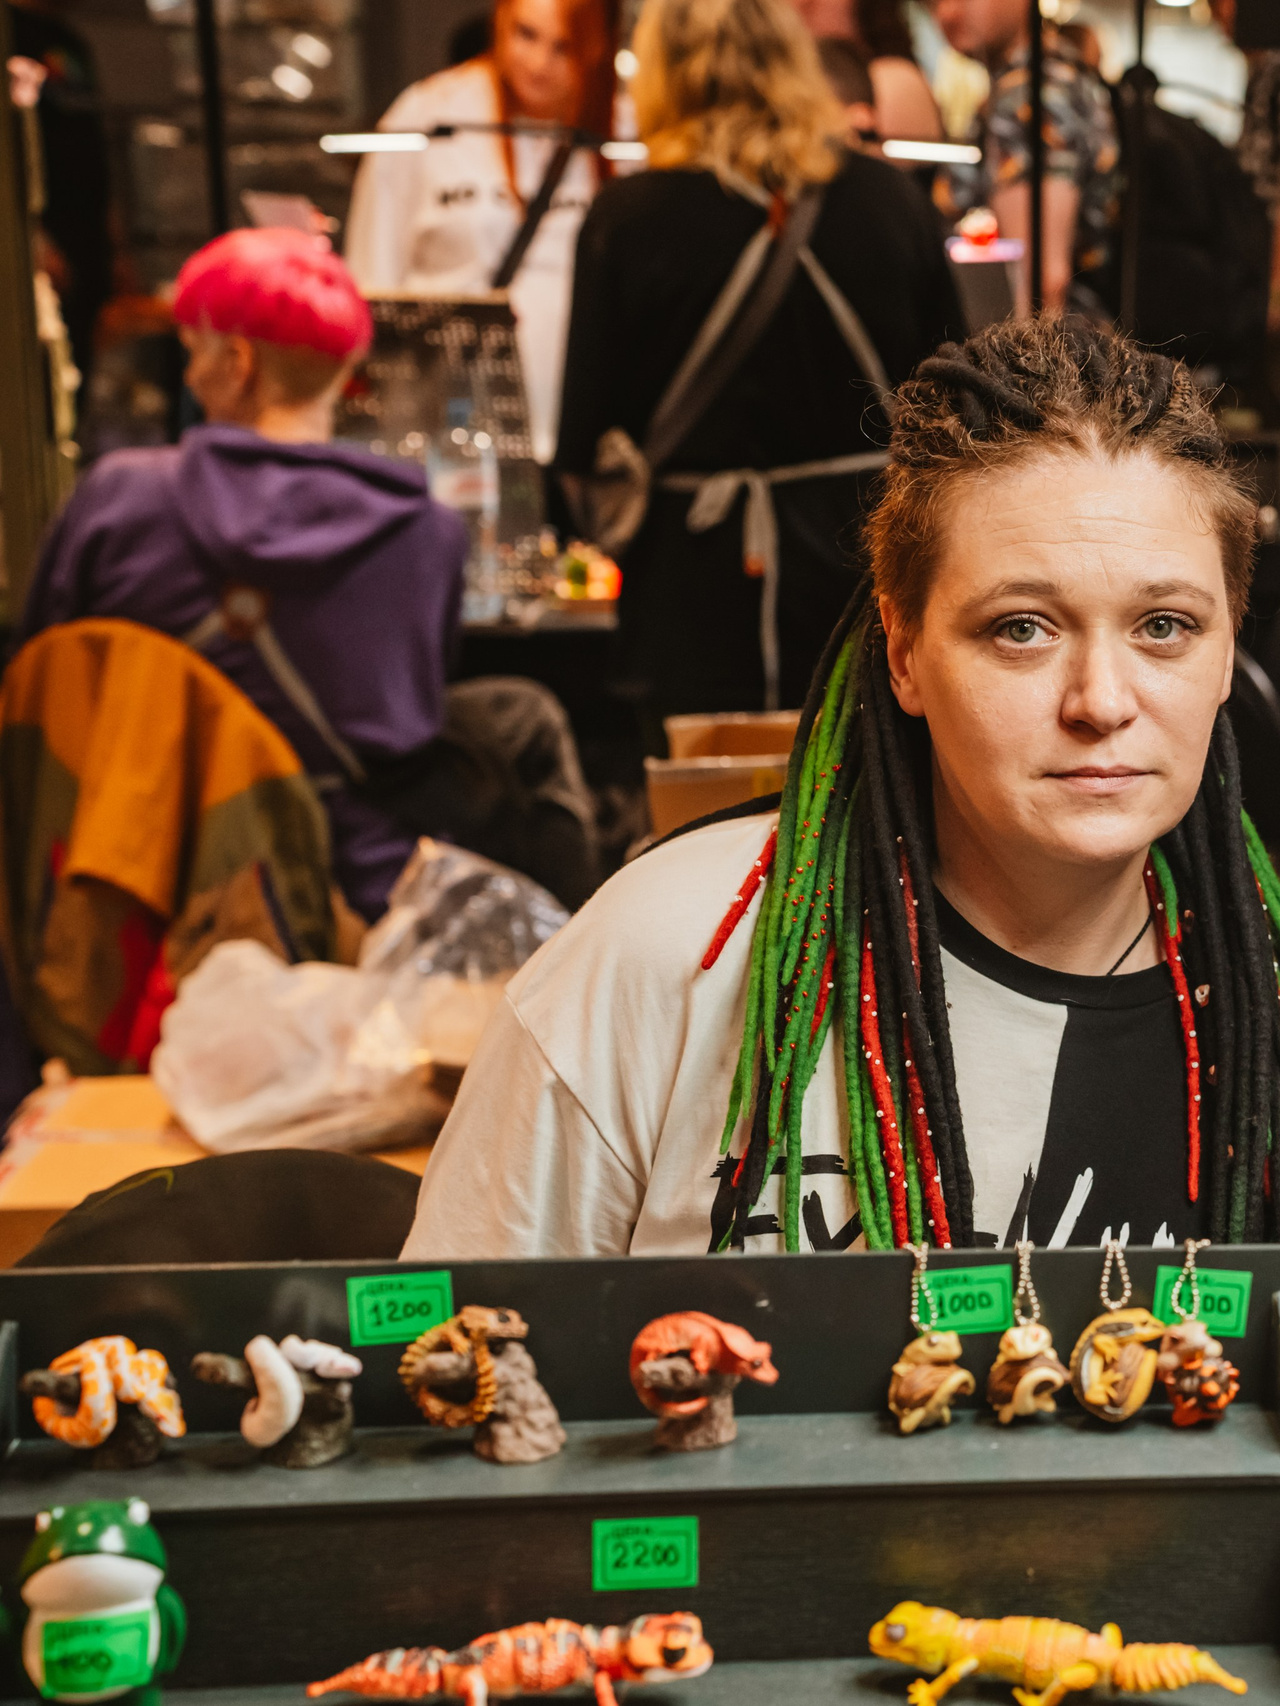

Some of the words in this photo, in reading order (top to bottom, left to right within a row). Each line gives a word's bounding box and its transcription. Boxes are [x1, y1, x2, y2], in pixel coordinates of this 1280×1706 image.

[369, 1301, 432, 1327] 1200
[937, 1291, 992, 1319] 1000
[612, 1541, 680, 1569] 2200
